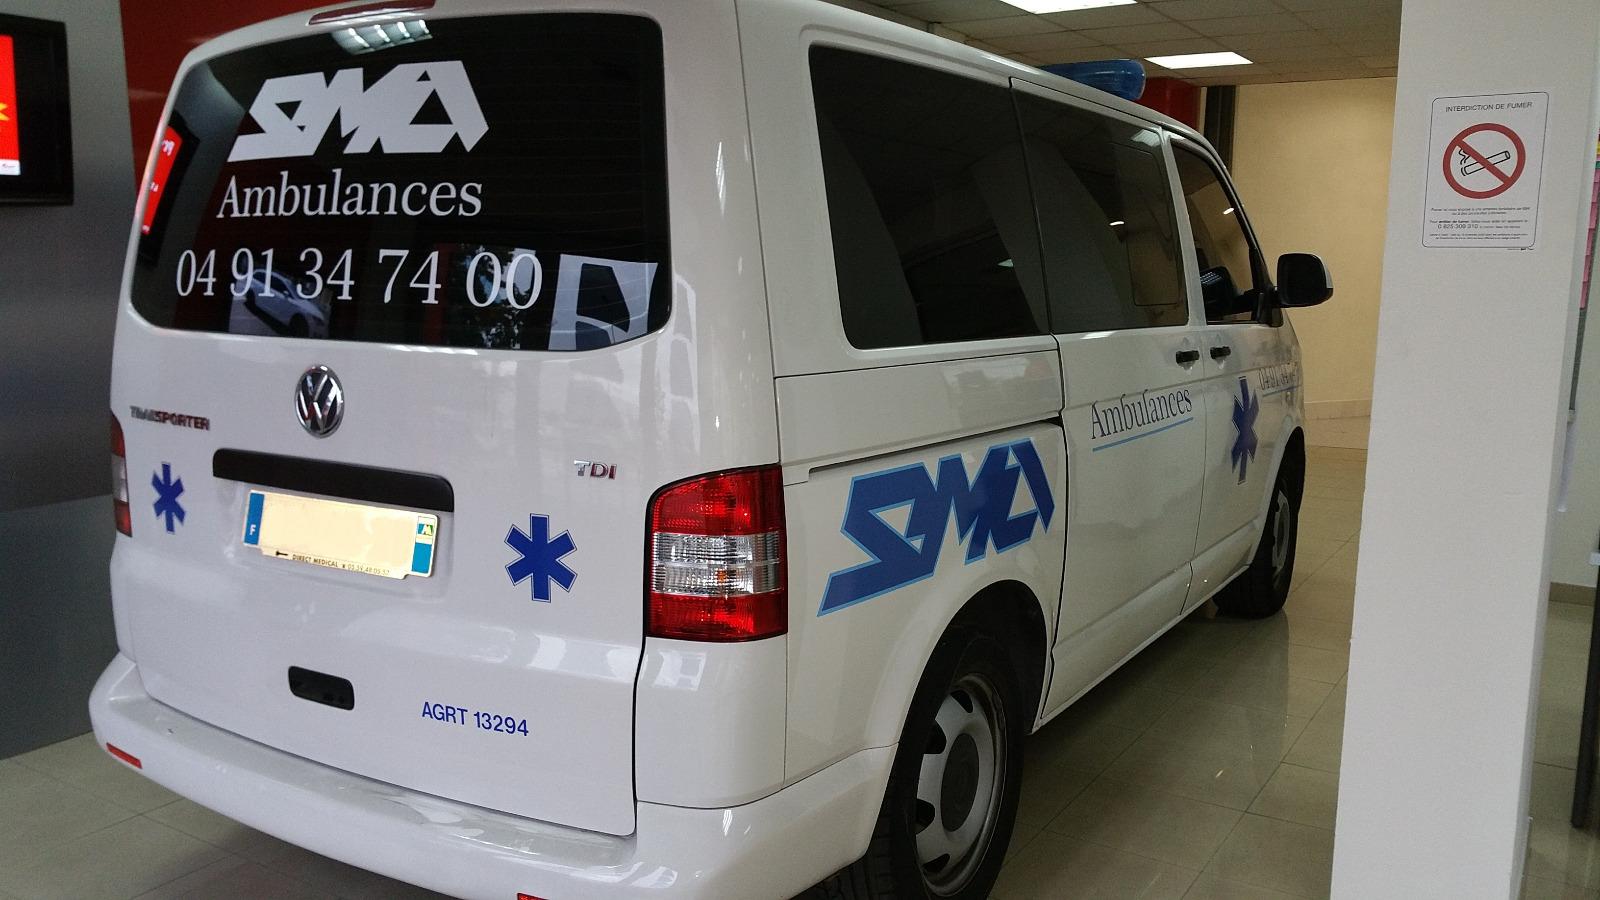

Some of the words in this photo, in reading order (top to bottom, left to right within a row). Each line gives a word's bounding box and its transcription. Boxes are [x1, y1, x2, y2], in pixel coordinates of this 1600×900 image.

[1445, 104, 1494, 112] INTERDICTION
[1507, 101, 1533, 109] FUMER
[216, 168, 483, 219] Ambulances
[176, 249, 217, 297] 04
[230, 247, 276, 298] 91
[297, 248, 355, 300] 34
[378, 249, 442, 305] 74
[465, 251, 543, 310] 00
[1091, 388, 1193, 440] Ambulances
[573, 460, 617, 480] TDI
[249, 524, 257, 536] F
[292, 553, 312, 563] DIRECT
[313, 558, 339, 569] MEDICAL
[421, 701, 468, 725] AGRT
[473, 711, 529, 737] 13294
